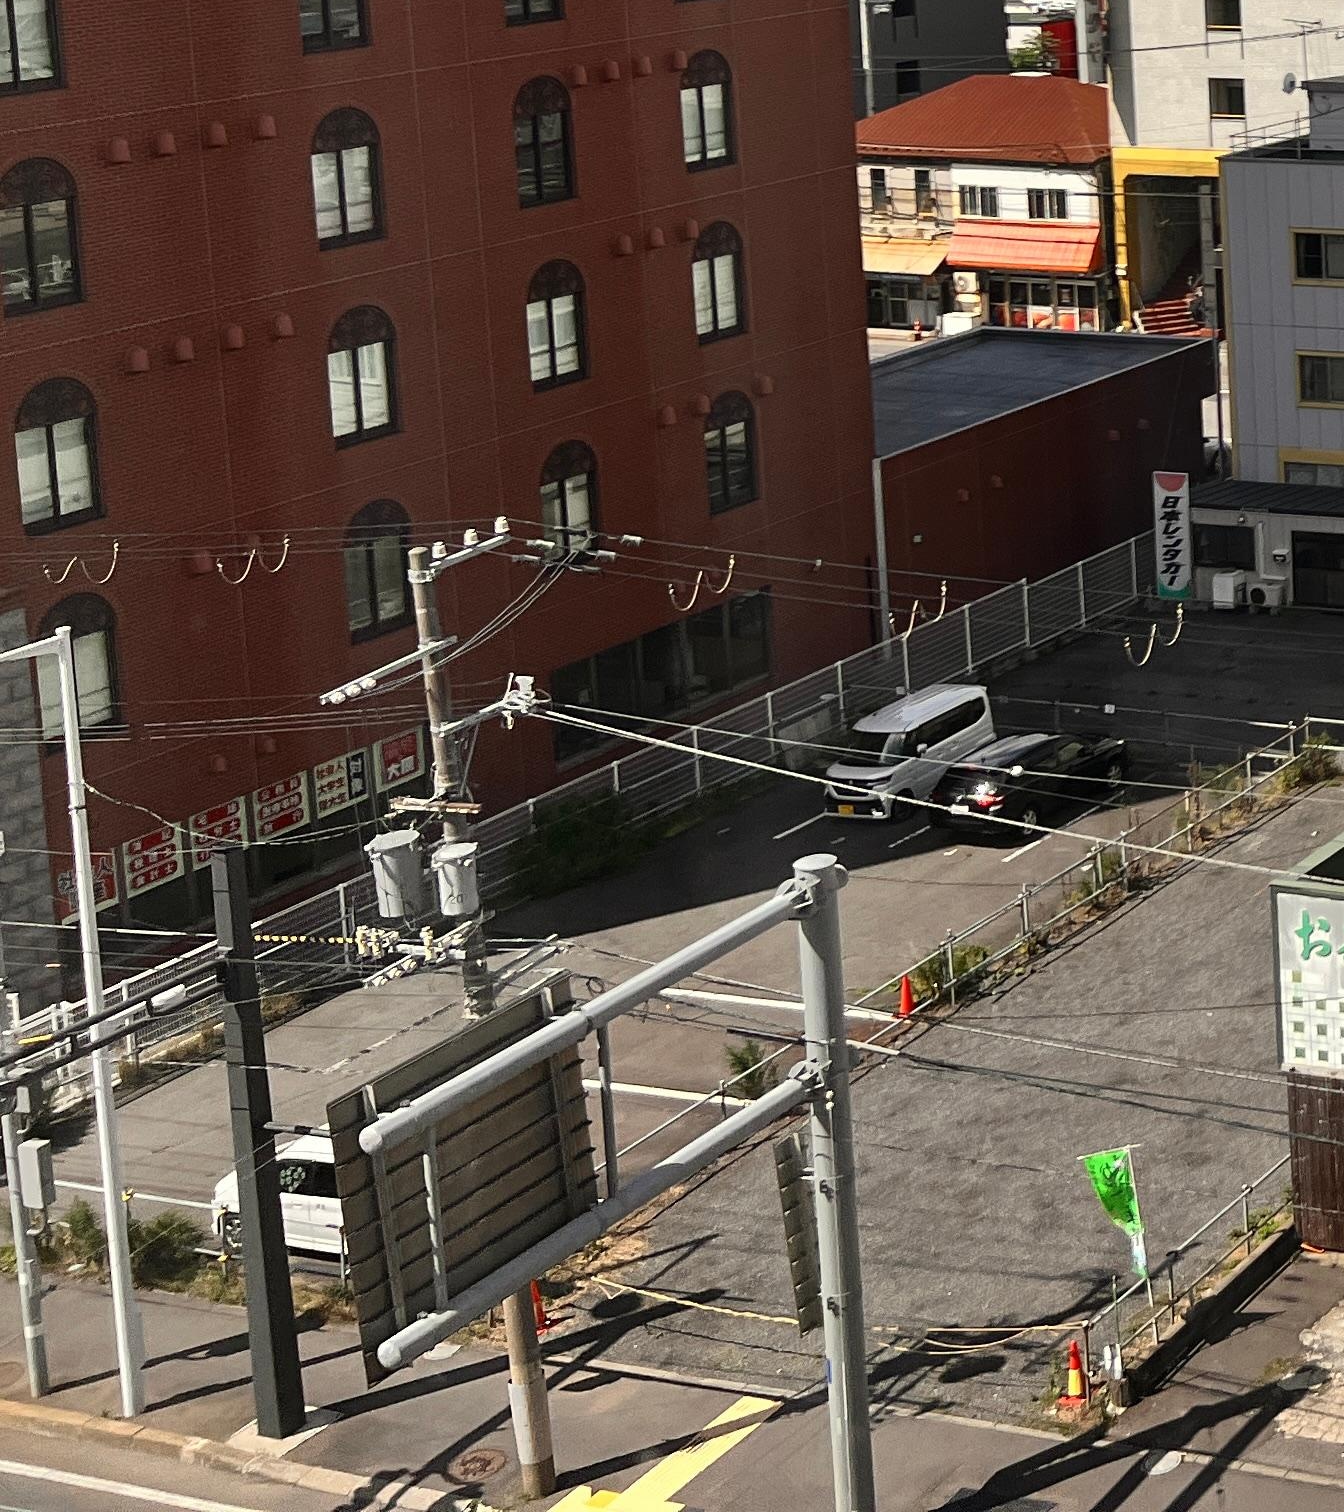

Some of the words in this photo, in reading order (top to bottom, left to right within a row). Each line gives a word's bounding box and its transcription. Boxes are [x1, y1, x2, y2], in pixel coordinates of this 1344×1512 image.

[1159, 496, 1185, 586] 日本レンタカー
